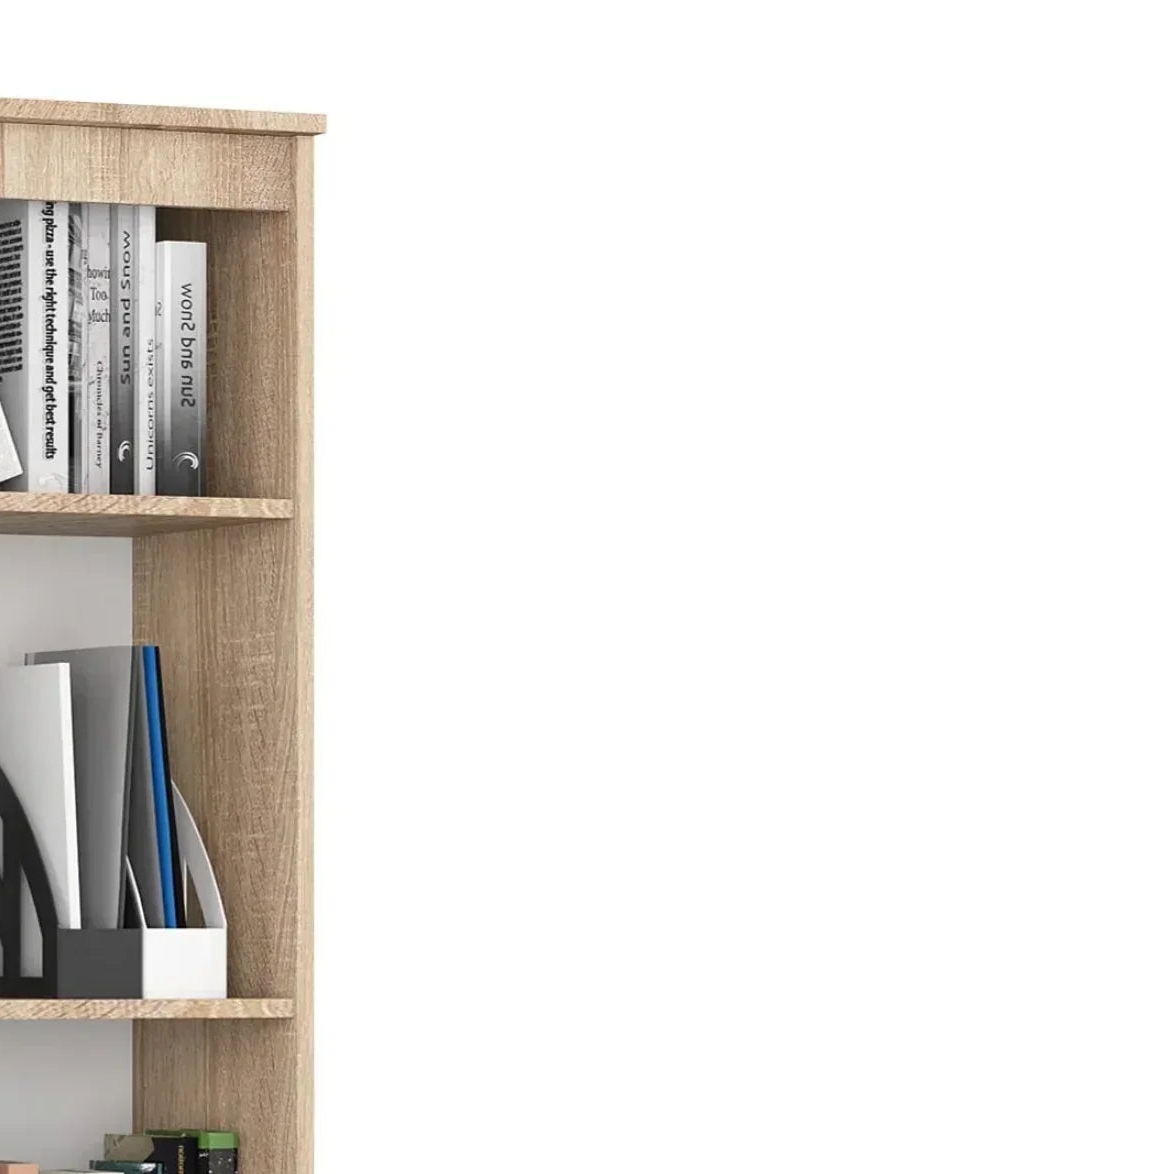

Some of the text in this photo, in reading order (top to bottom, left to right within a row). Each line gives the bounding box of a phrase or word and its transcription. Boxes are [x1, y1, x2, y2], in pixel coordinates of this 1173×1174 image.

[42, 218, 57, 243] pizza
[45, 250, 55, 267] use
[45, 269, 57, 285] the
[42, 287, 57, 312] right
[90, 288, 107, 301] Too
[120, 231, 131, 385] Sun and Snow
[42, 314, 57, 363] technique
[45, 365, 57, 384] and
[42, 386, 57, 402] get
[95, 361, 104, 416] Chronicles
[45, 404, 57, 425] best
[146, 338, 154, 471] Unicorns exists
[45, 427, 57, 459] results
[95, 432, 104, 469] Barney
